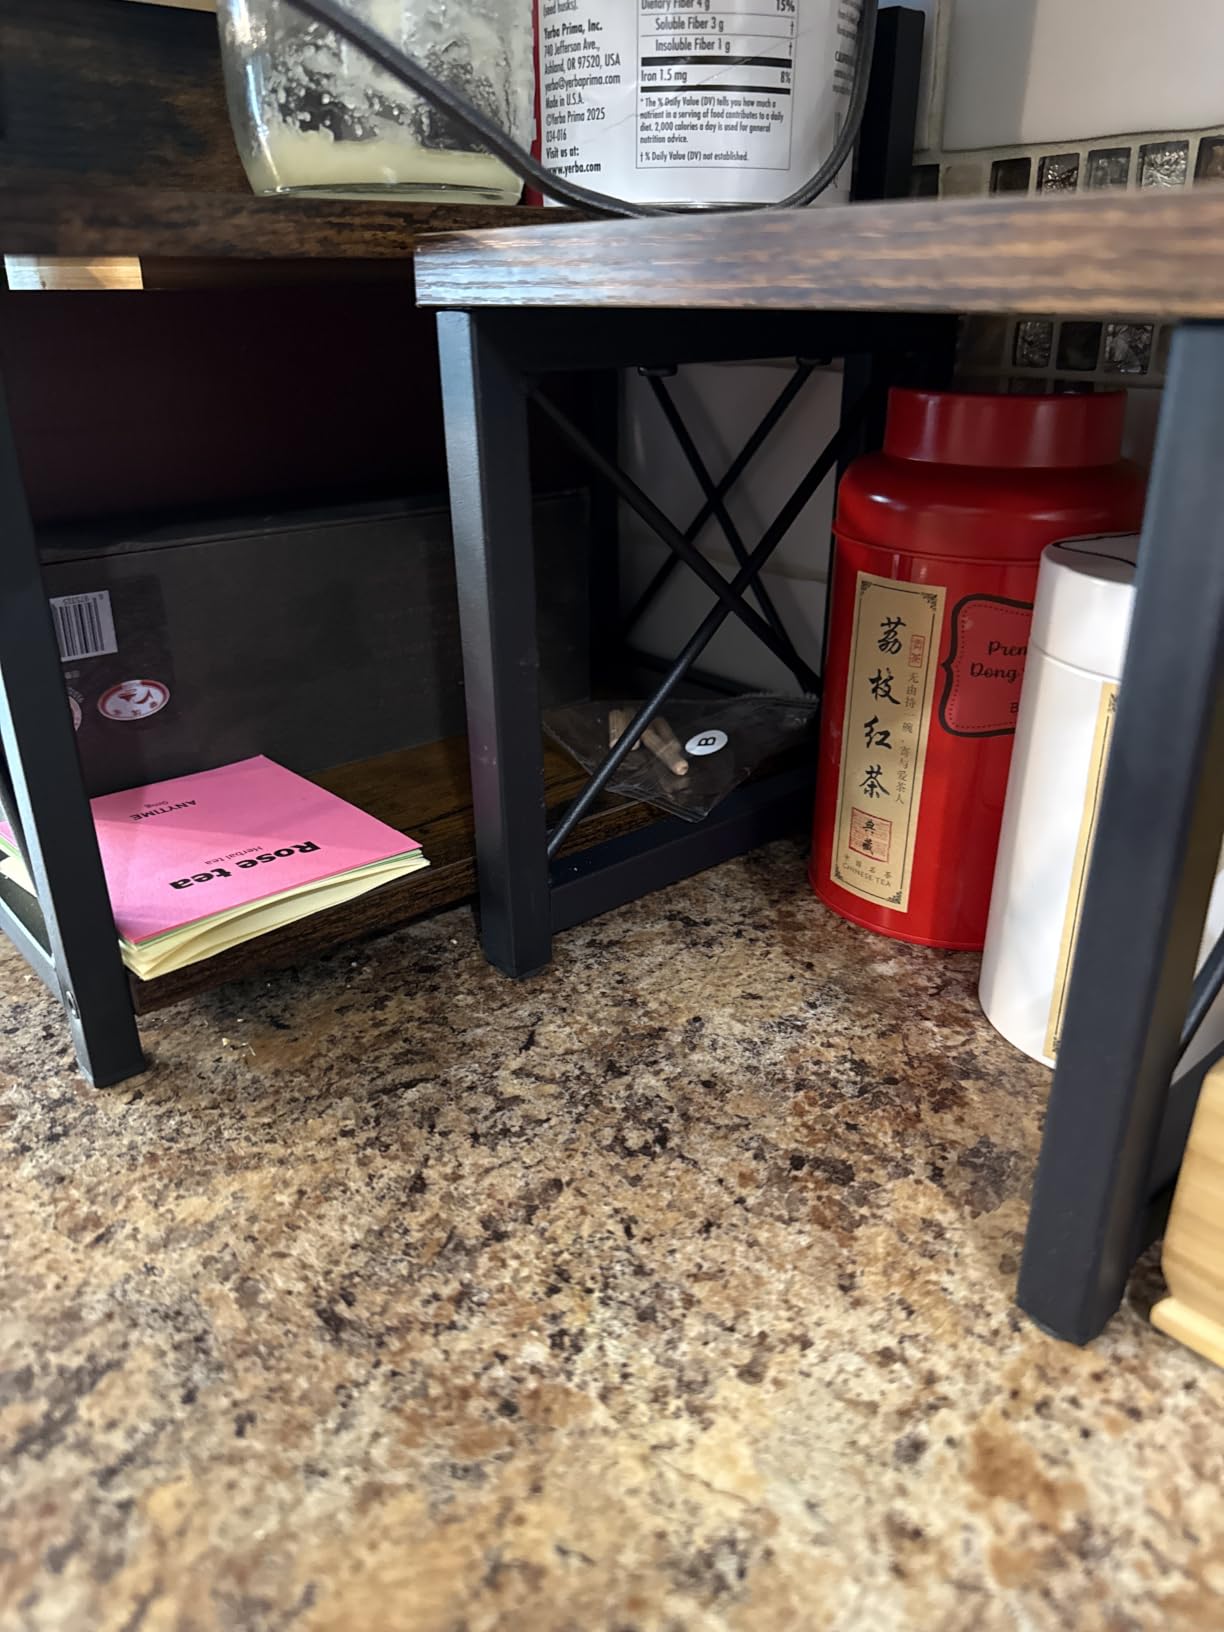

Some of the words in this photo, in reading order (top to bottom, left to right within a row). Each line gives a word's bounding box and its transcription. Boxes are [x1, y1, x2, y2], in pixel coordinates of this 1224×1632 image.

[544, 25, 560, 40] Yerba
[562, 22, 585, 36] Prima,
[588, 19, 602, 32] Inc.
[656, 17, 685, 30] Soluble
[688, 17, 708, 29] Fiber
[711, 17, 716, 28] 3
[719, 20, 724, 32] g
[554, 40, 581, 55] Jefferson
[656, 37, 692, 51] Insoluble
[694, 37, 715, 50] Fiber
[718, 38, 722, 49] 1
[725, 42, 730, 53] g
[567, 58, 575, 70] OR
[578, 54, 602, 69] 97520,
[605, 53, 620, 66] USA
[641, 70, 657, 81] Iron
[660, 69, 672, 81] 1.5
[674, 70, 687, 83] mg
[780, 71, 791, 83] 8%
[545, 74, 620, 94] yerba@yerbaprima.com
[546, 95, 558, 109] Made
[560, 96, 564, 107] in
[566, 92, 584, 106] U.S.A.
[646, 98, 656, 107] The
[658, 98, 663, 106] %
[664, 98, 680, 108] Daily
[682, 97, 699, 106] Value
[701, 96, 715, 106] (DV)
[717, 97, 729, 106] tells
[731, 99, 741, 108] you
[743, 98, 754, 107] how
[756, 98, 771, 108] much
[568, 110, 585, 123] Prima
[587, 107, 605, 120] 2025
[640, 111, 664, 119] nutrient
[678, 110, 700, 120] serving
[702, 109, 709, 118] of
[711, 109, 724, 118] food
[726, 109, 758, 119] contributes
[759, 111, 765, 120] to
[771, 112, 784, 122] daily
[640, 122, 653, 131] diet.
[655, 122, 673, 132] 2,000
[675, 121, 698, 131] calories
[705, 122, 716, 133] day
[718, 122, 722, 131] is
[724, 122, 738, 131] used
[740, 122, 748, 131] for
[750, 123, 771, 133] general
[640, 134, 666, 143] nutrition
[667, 134, 688, 143] advice.
[546, 147, 558, 159] Visit
[560, 148, 567, 157] us
[570, 146, 579, 156] at:
[645, 152, 650, 160] %
[652, 152, 668, 162] Daily
[669, 152, 686, 160] Value
[687, 151, 701, 161] (DV)
[703, 152, 713, 160] not
[715, 151, 748, 161] established.
[970, 662, 1017, 683] Dong
[858, 616, 906, 798] 荔枝红茶
[697, 736, 716, 746] B
[130, 800, 198, 820] ANYTIME
[225, 846, 263, 860] Herbal
[235, 841, 321, 869] Rose
[169, 868, 232, 890] tea
